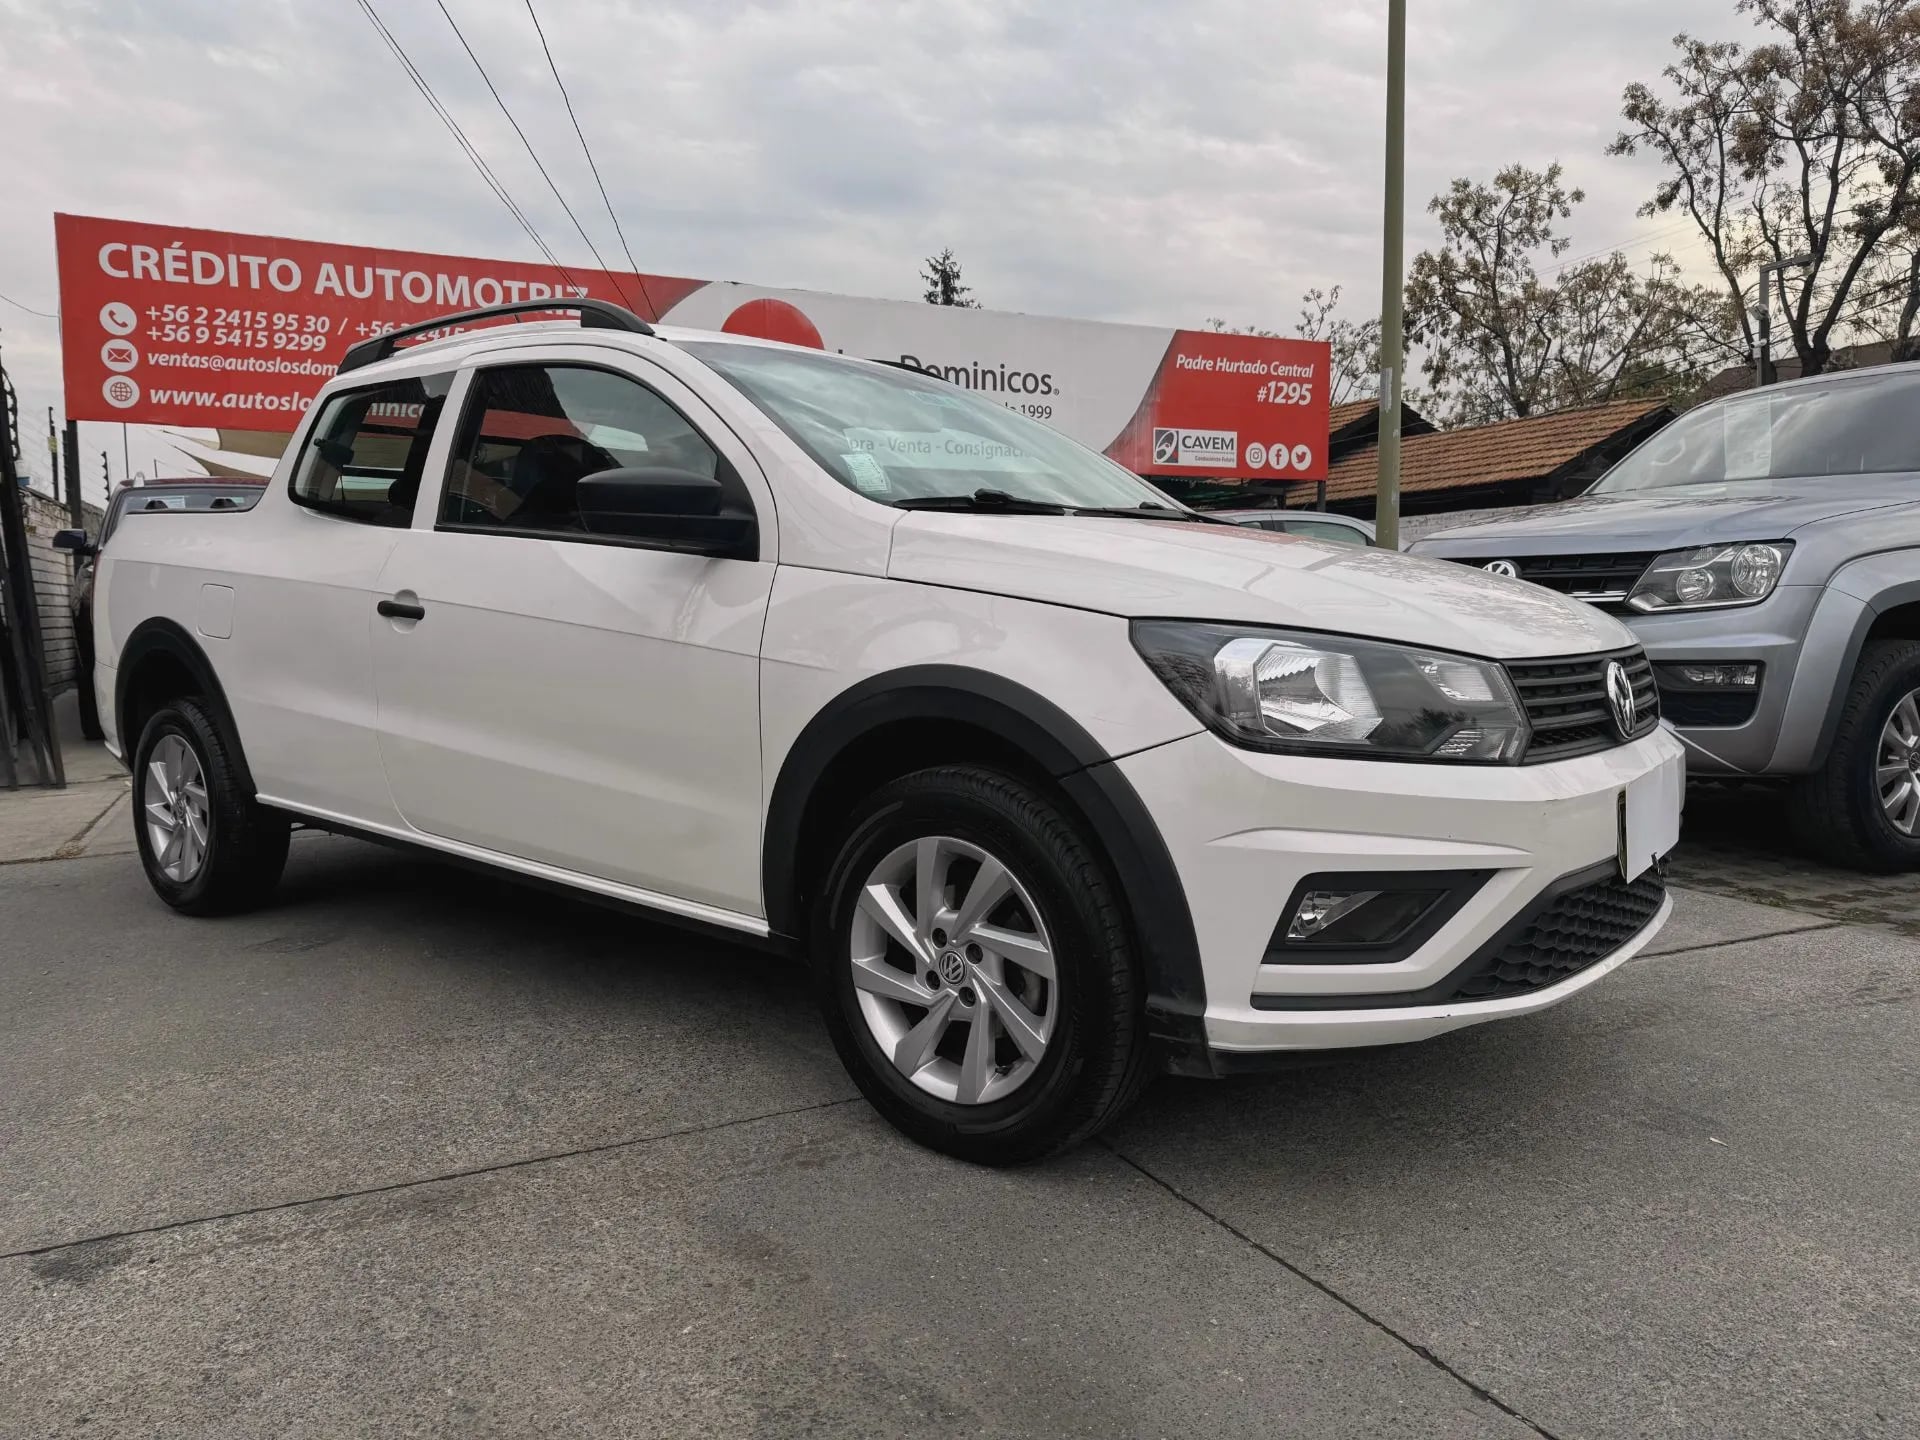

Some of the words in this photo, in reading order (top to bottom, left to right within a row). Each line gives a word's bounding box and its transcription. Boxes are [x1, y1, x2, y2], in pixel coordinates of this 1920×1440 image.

[98, 241, 302, 293] CRÉDITO
[314, 263, 588, 316] AUTOMOTRIZ
[146, 304, 190, 323] +56
[194, 306, 208, 324] 2
[212, 308, 268, 329] 2415
[272, 312, 299, 331] 95
[303, 315, 330, 333] 30
[146, 324, 191, 343] +56
[195, 327, 209, 344] 9
[214, 328, 269, 349] 5415
[273, 332, 327, 352] 9299
[1176, 354, 1213, 371] Padre
[1216, 357, 1268, 375] Hurtado
[1270, 361, 1314, 378] Central
[1257, 381, 1312, 406] #1295
[1020, 404, 1052, 419] 1999
[887, 437, 931, 453] Venta
[1182, 435, 1234, 450] CAVEM
